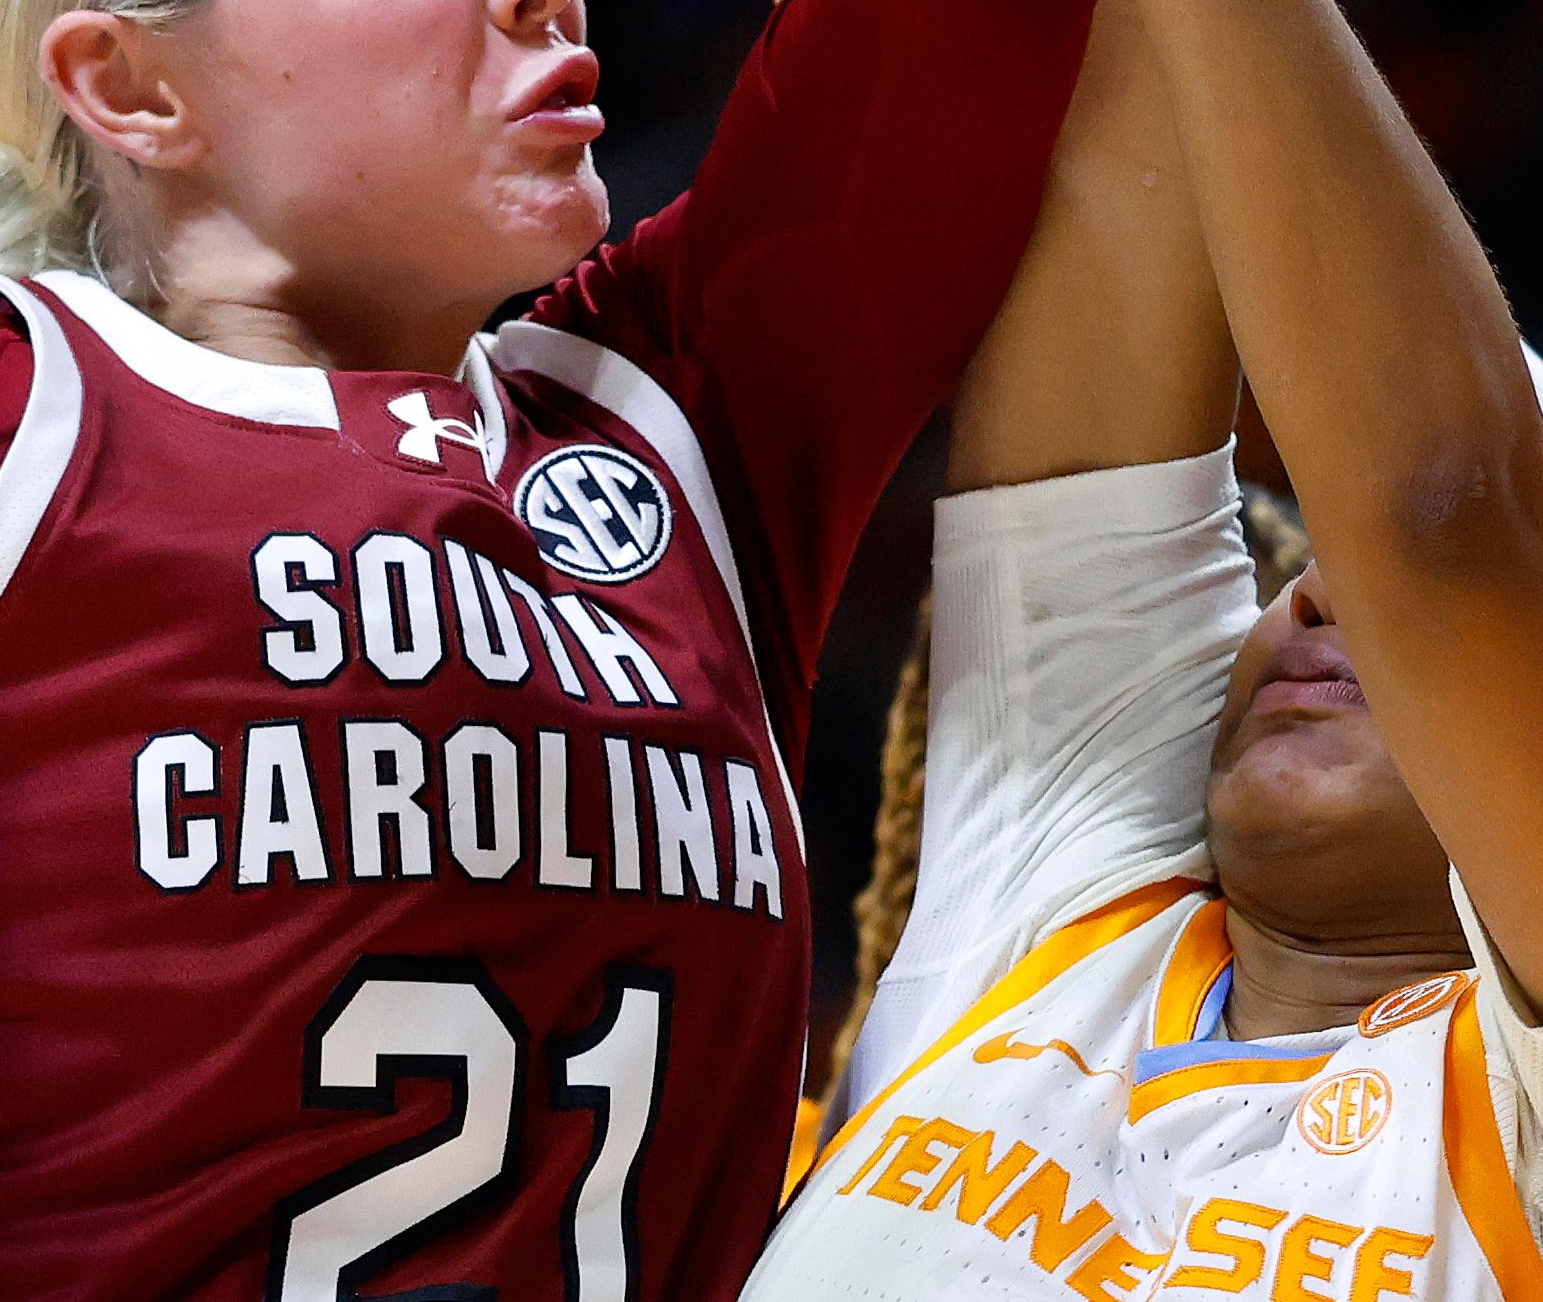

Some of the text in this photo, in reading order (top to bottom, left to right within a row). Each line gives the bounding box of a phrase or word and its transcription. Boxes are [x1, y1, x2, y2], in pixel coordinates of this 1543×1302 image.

[523, 455, 663, 574] SEC
[251, 531, 681, 707] SOUTH
[132, 719, 785, 922] CAROLINA
[277, 974, 663, 1302] 21
[1306, 1071, 1389, 1151] SEC
[835, 1115, 1436, 1302] TENNESEE
